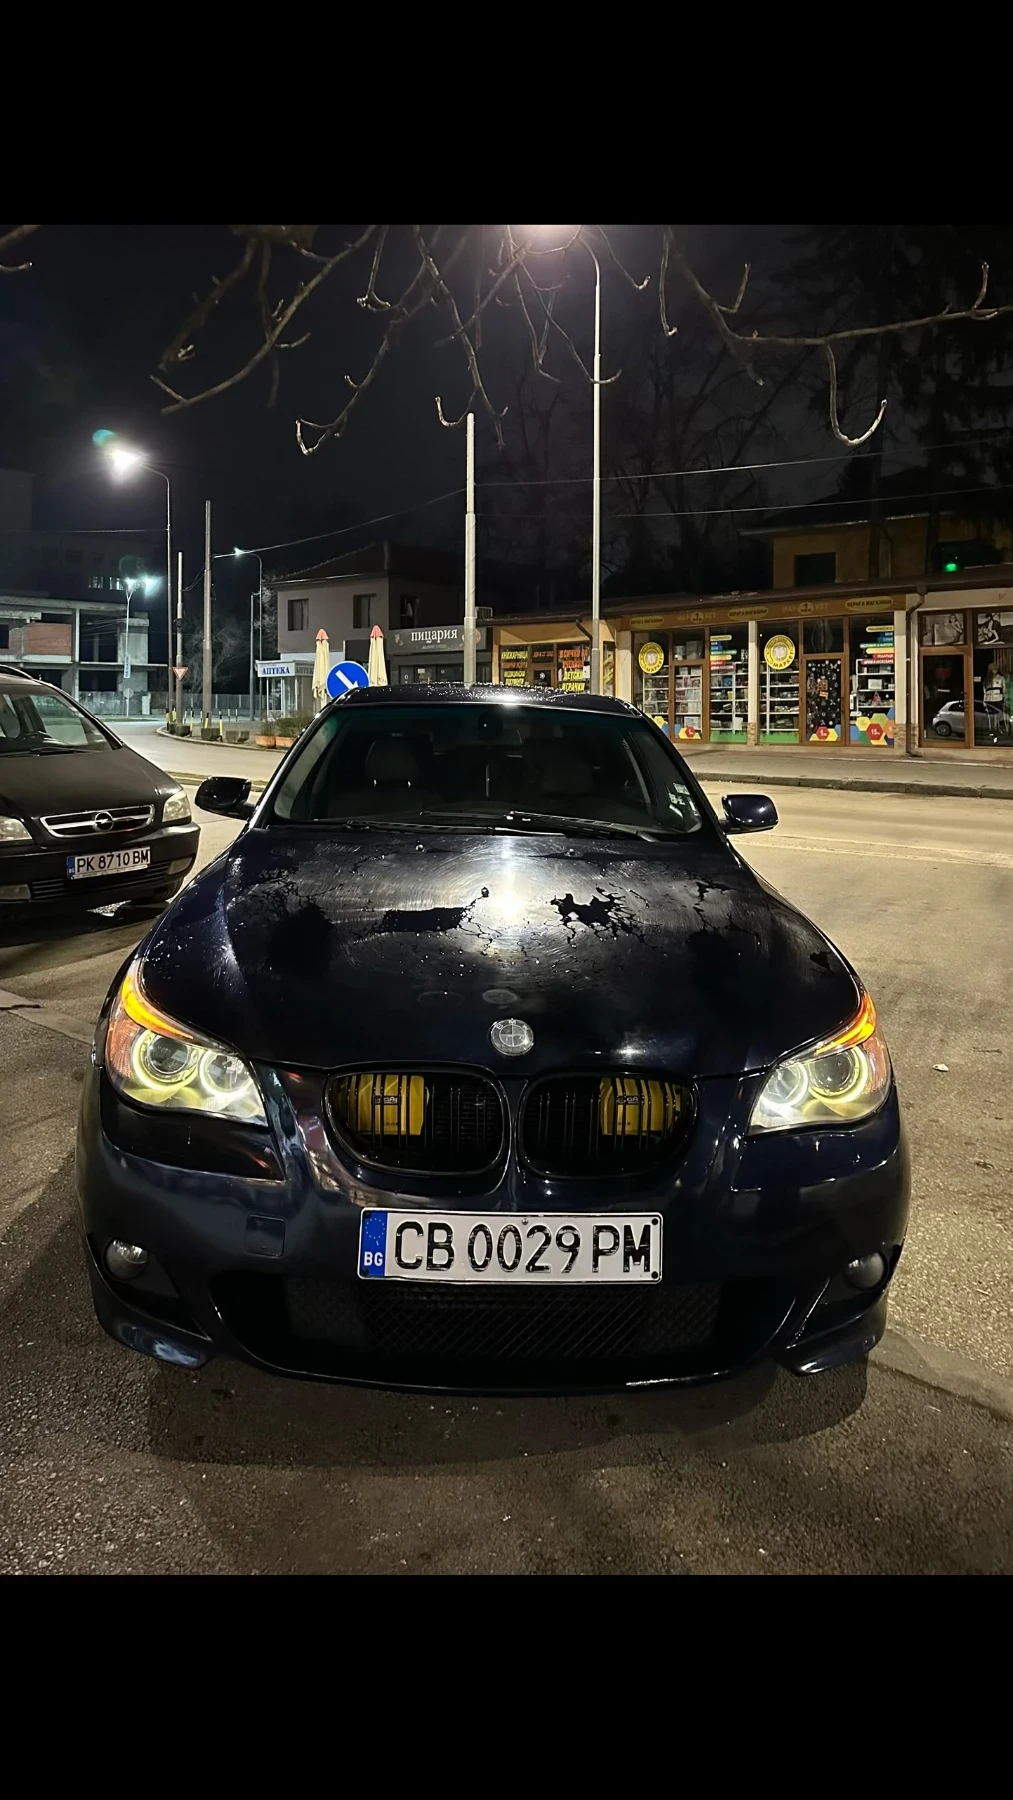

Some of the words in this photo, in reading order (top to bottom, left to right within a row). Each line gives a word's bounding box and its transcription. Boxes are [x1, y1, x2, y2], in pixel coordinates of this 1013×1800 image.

[411, 629, 458, 644] пицария
[262, 666, 290, 674] АПТЕКА
[77, 857, 95, 872] PK
[98, 852, 130, 870] 8710
[132, 849, 148, 864] BM
[394, 1221, 455, 1272] CB
[467, 1223, 581, 1274] 0029
[592, 1225, 652, 1274] PM
[363, 1252, 384, 1267] BG
